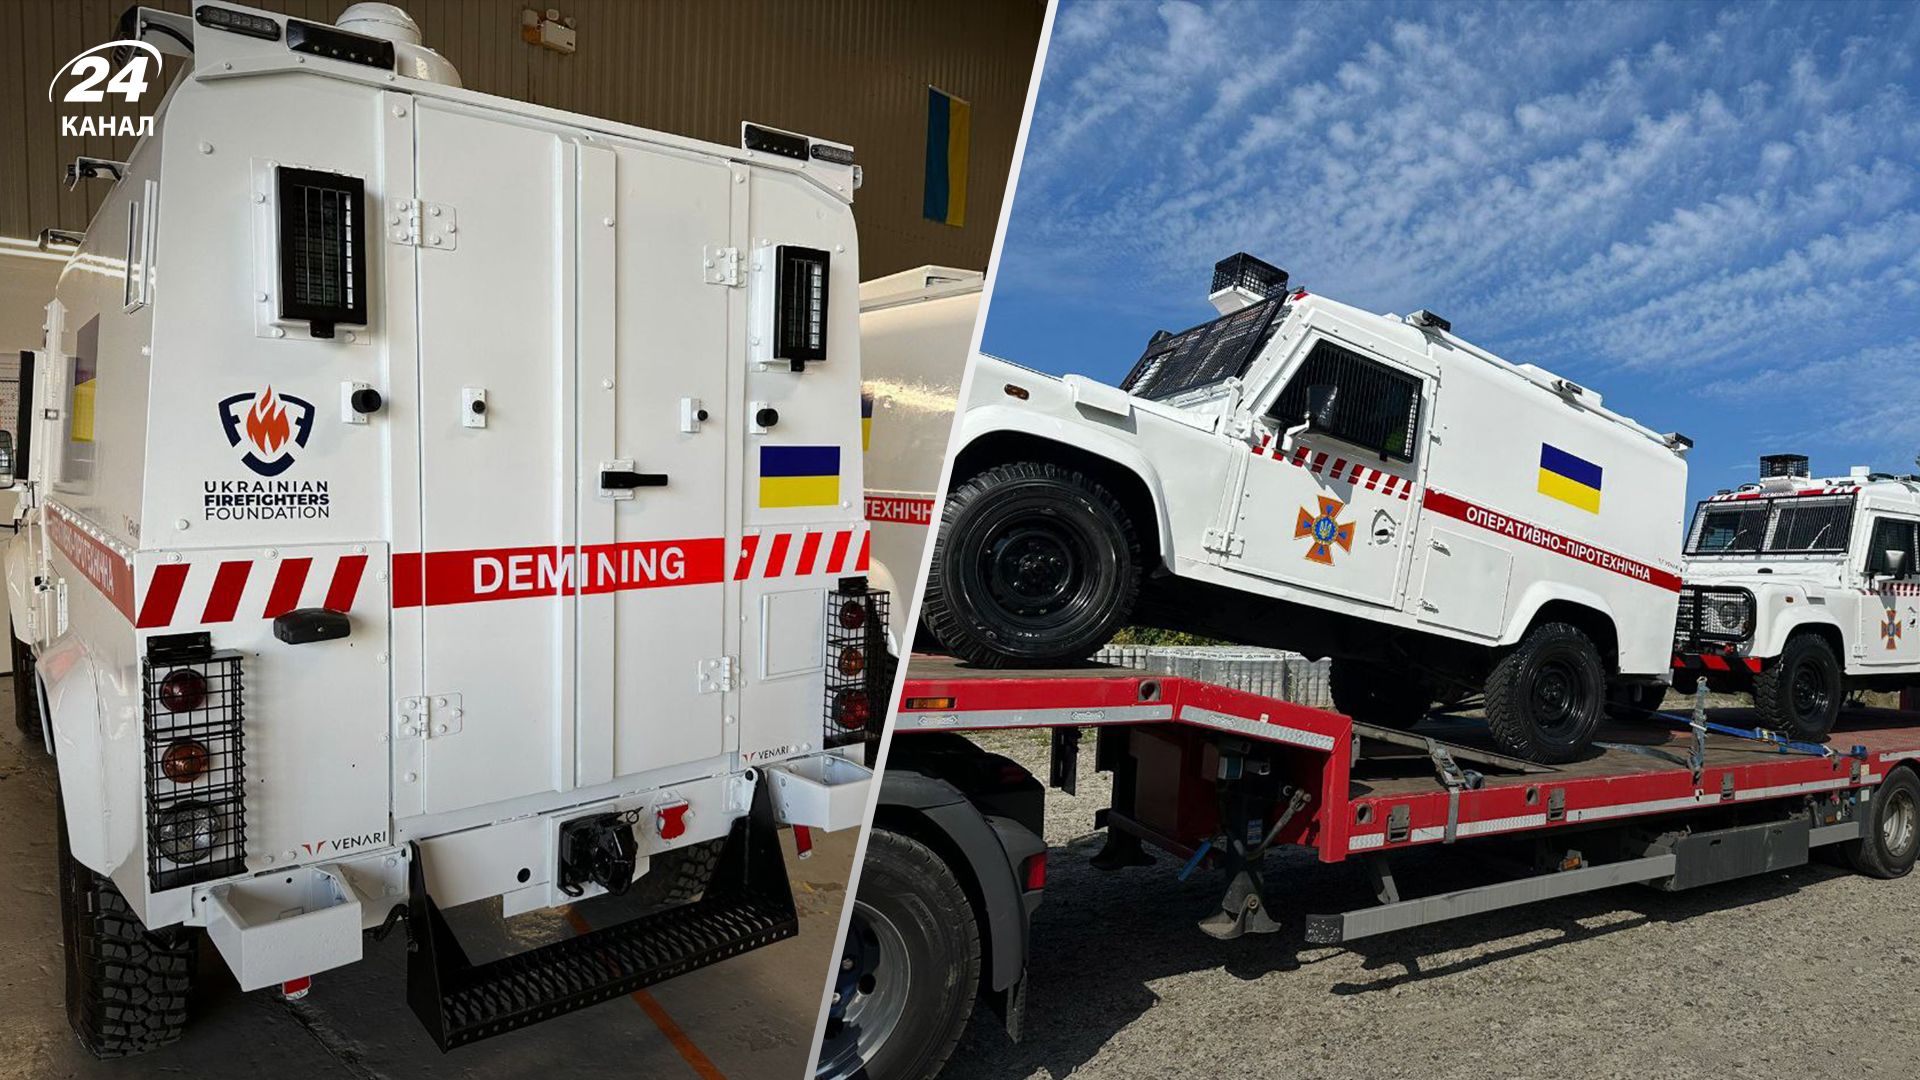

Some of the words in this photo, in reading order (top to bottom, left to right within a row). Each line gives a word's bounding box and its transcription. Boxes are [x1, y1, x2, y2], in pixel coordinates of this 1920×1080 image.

[204, 480, 328, 493] UKRAINIAN
[204, 494, 330, 506] FIREFIGHTERS
[205, 506, 330, 520] FOUNDATION
[1466, 507, 1650, 580] ОПЕРАТИВНО-ПІРОТЕХНІЧНА
[473, 547, 685, 594] DEMINING
[759, 745, 789, 759] VENARI
[331, 831, 386, 850] VENARI
